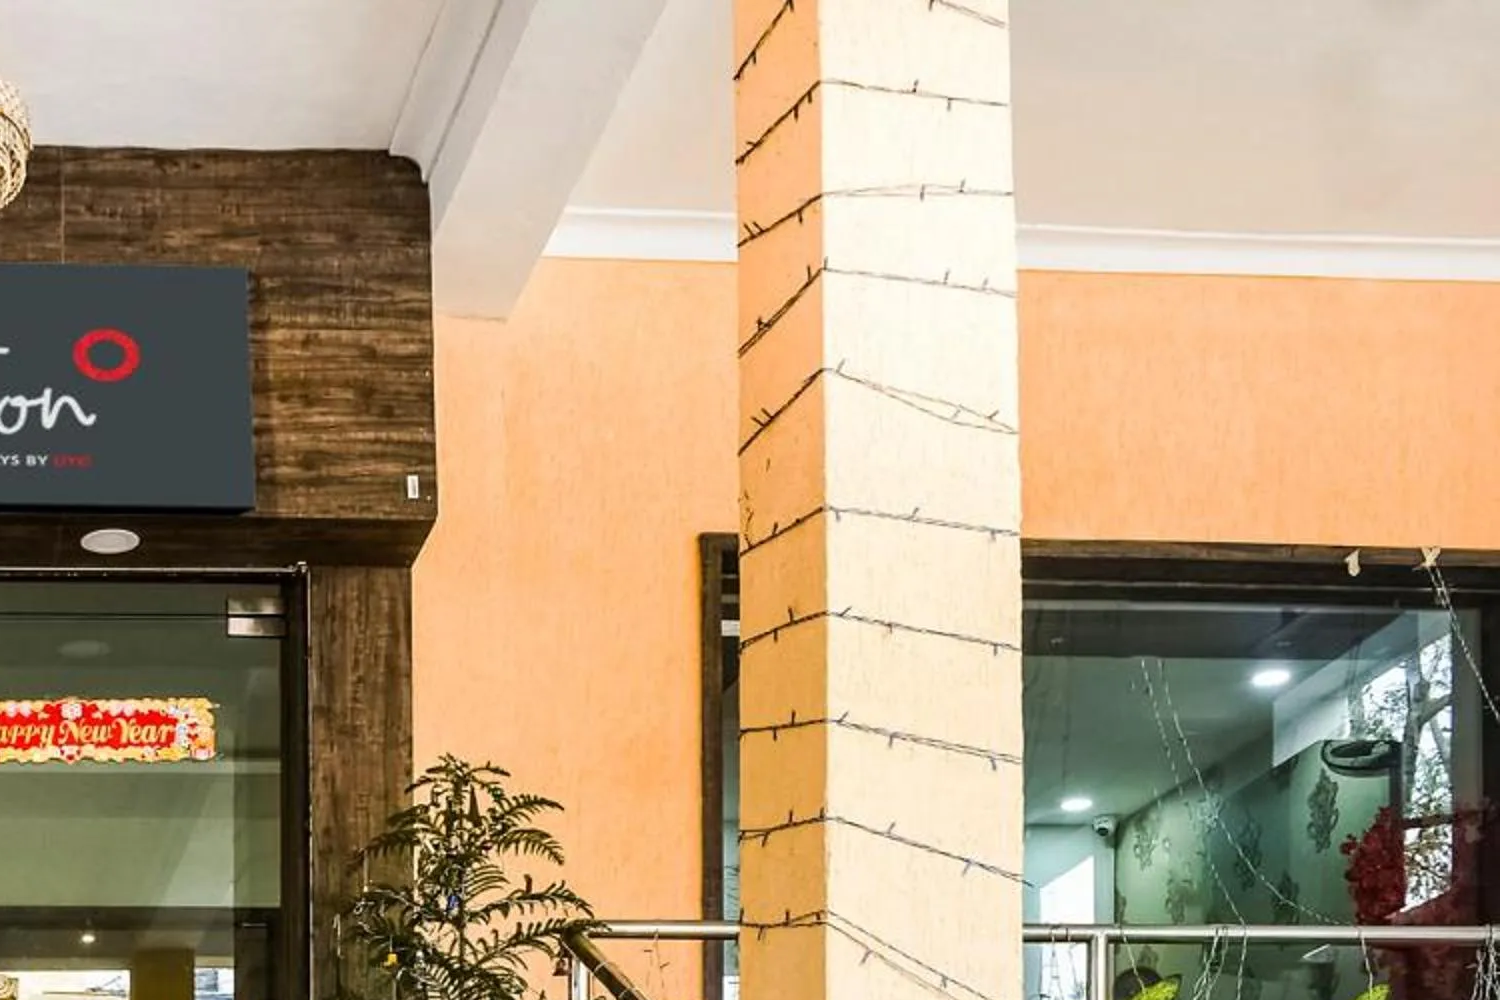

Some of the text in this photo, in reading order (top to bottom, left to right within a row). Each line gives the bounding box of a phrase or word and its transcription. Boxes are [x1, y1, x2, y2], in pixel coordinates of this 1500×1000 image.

[25, 453, 49, 467] BY
[59, 718, 112, 745] New
[113, 719, 175, 744] Year
